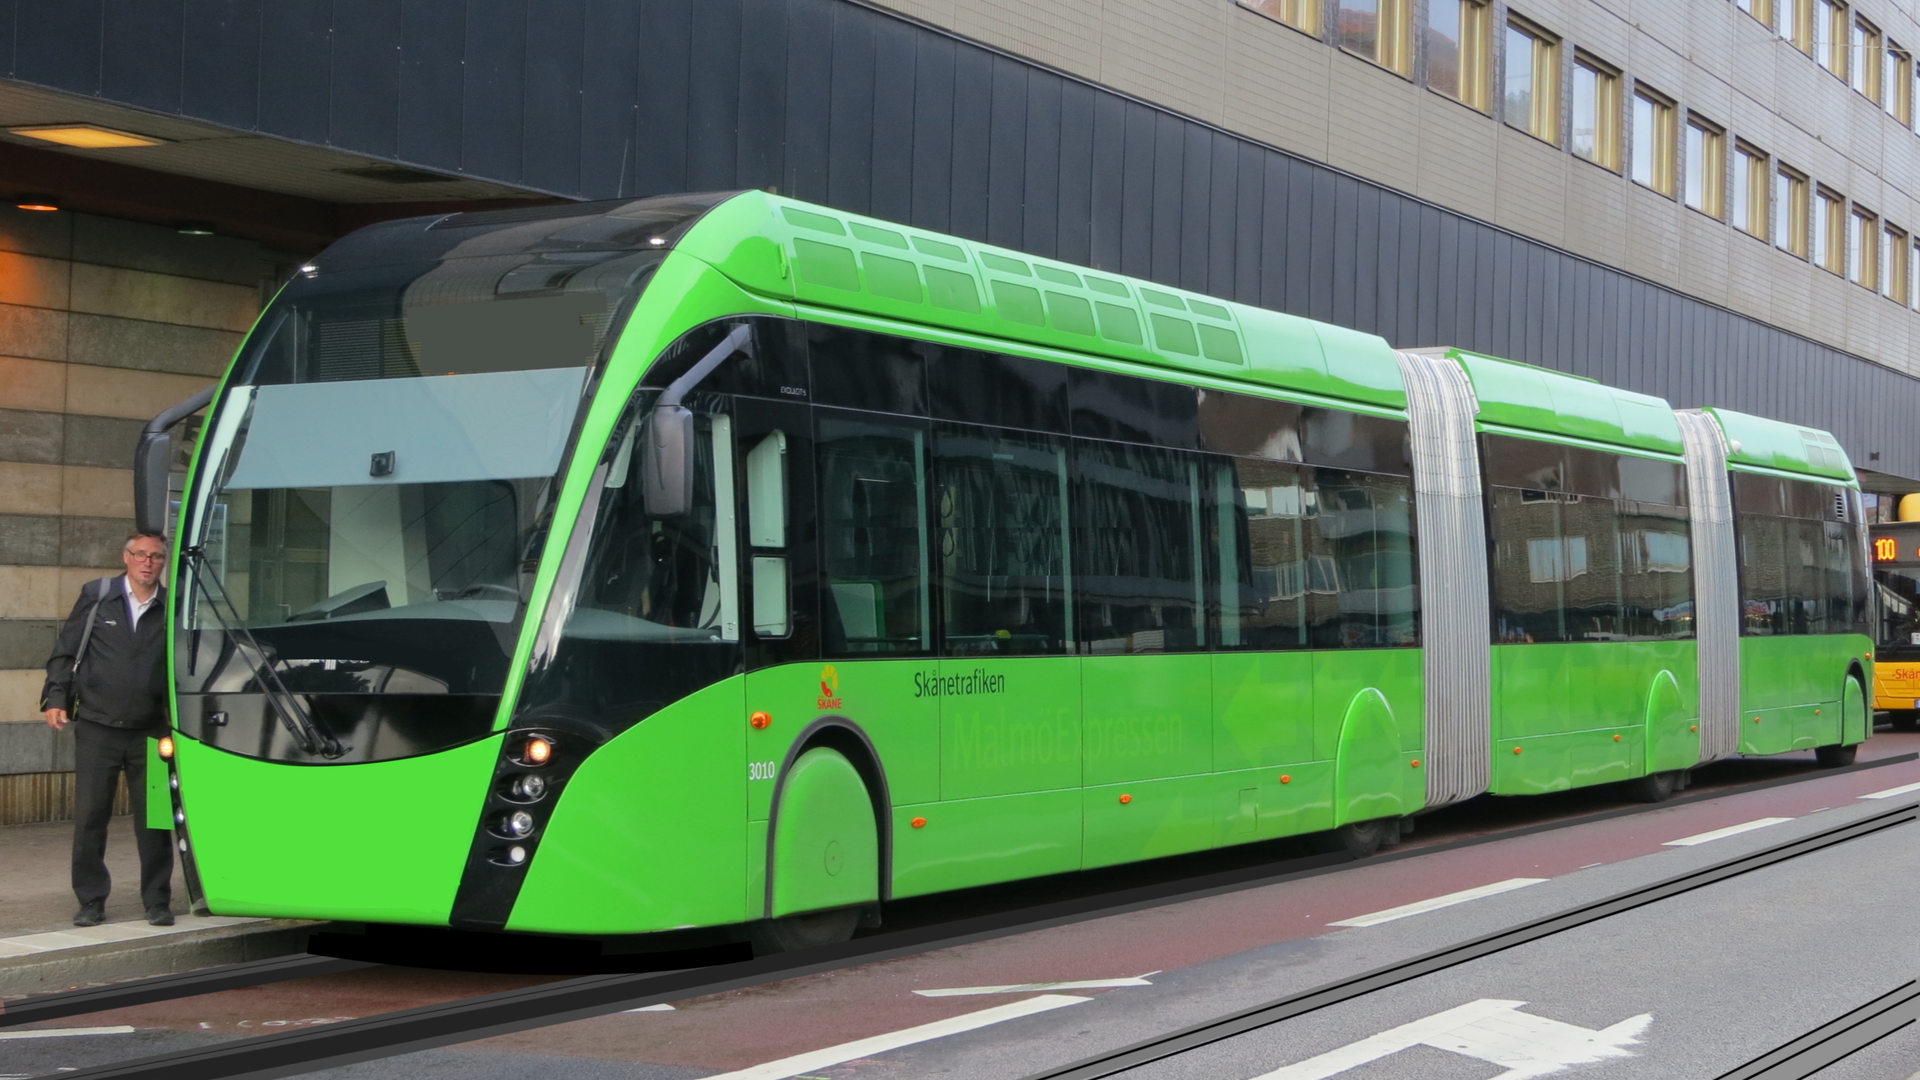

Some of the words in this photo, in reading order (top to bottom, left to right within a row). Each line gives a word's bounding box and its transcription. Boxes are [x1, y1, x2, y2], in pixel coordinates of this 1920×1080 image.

[1874, 538, 1896, 561] 100
[914, 668, 1005, 698] Skånetrafiken
[952, 706, 1184, 774] MalmöExpressen
[748, 761, 775, 780] 3010
